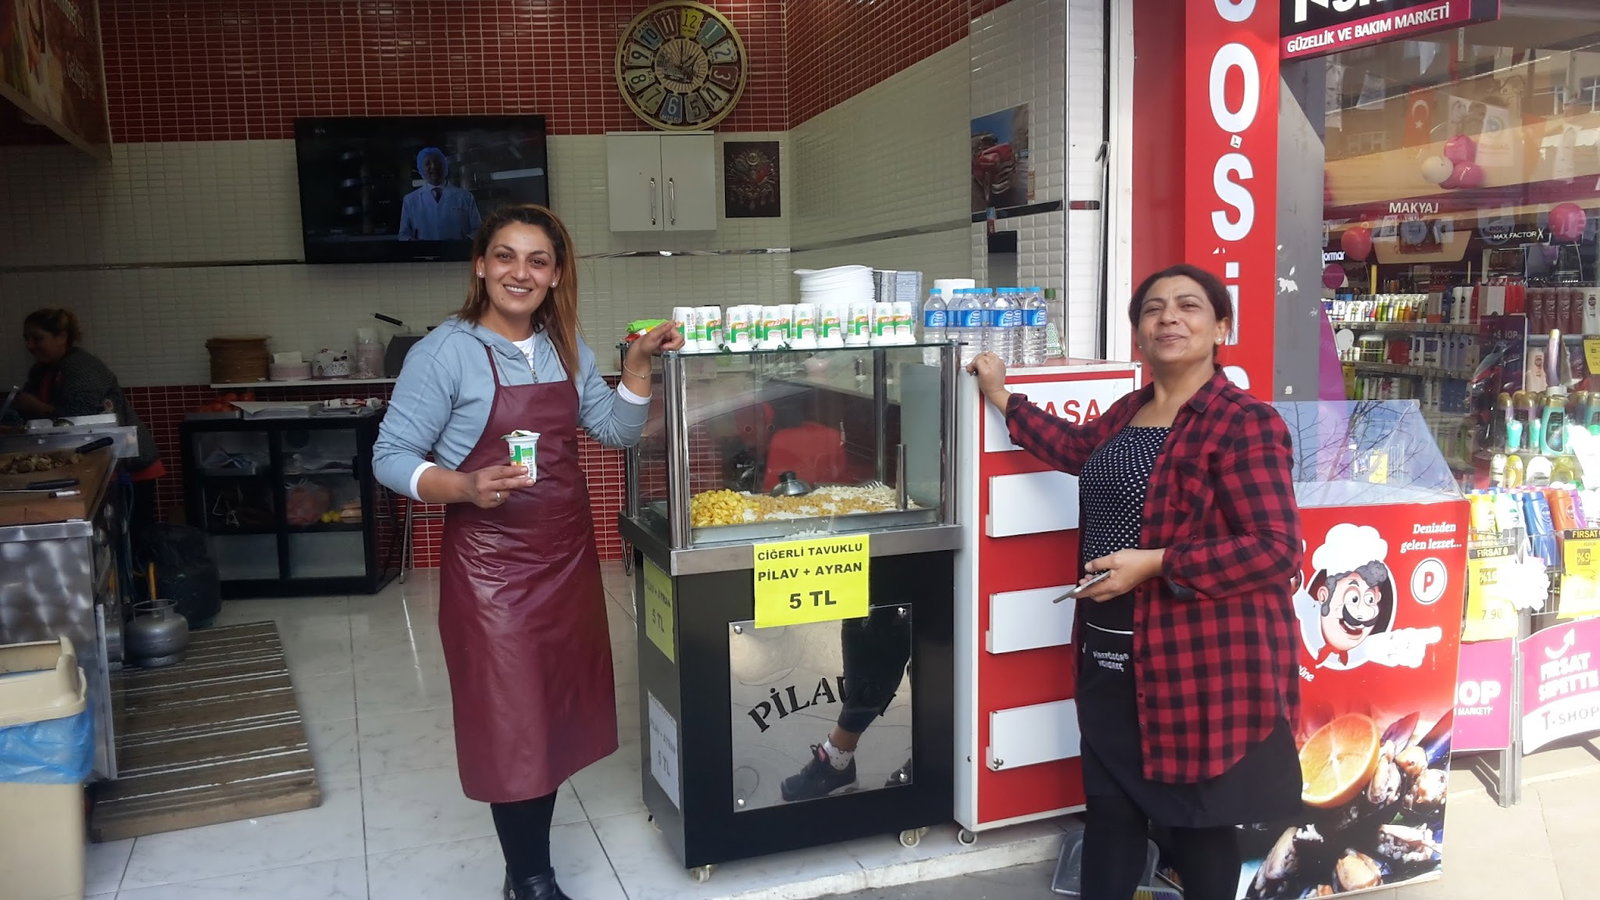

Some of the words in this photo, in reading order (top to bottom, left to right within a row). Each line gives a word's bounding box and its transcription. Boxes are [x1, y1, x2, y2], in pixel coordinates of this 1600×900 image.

[682, 14, 698, 29] 12
[1287, 30, 1335, 53] GÜZELLİK
[1337, 26, 1352, 43] VE
[1354, 17, 1392, 38] BAKIM
[1394, 1, 1450, 30] MARKETİ
[667, 96, 679, 115] 6
[1389, 202, 1440, 214] MAKYAJ
[1493, 232, 1508, 240] MAX
[1508, 231, 1537, 239] FACTOR
[1031, 399, 1102, 426] ASA
[1412, 521, 1457, 534] Denizden
[1572, 530, 1598, 539] FIRSAT
[757, 546, 804, 561] CİĞERLİ
[808, 542, 863, 556] TAVUKLU
[1400, 538, 1427, 554] gelen
[1476, 547, 1503, 558] FIRSAT
[758, 568, 799, 582] PİLAV
[803, 568, 811, 576] +
[815, 562, 862, 576] AYRAN
[1423, 571, 1435, 593] P
[789, 592, 802, 609] 5
[809, 589, 837, 607] TL
